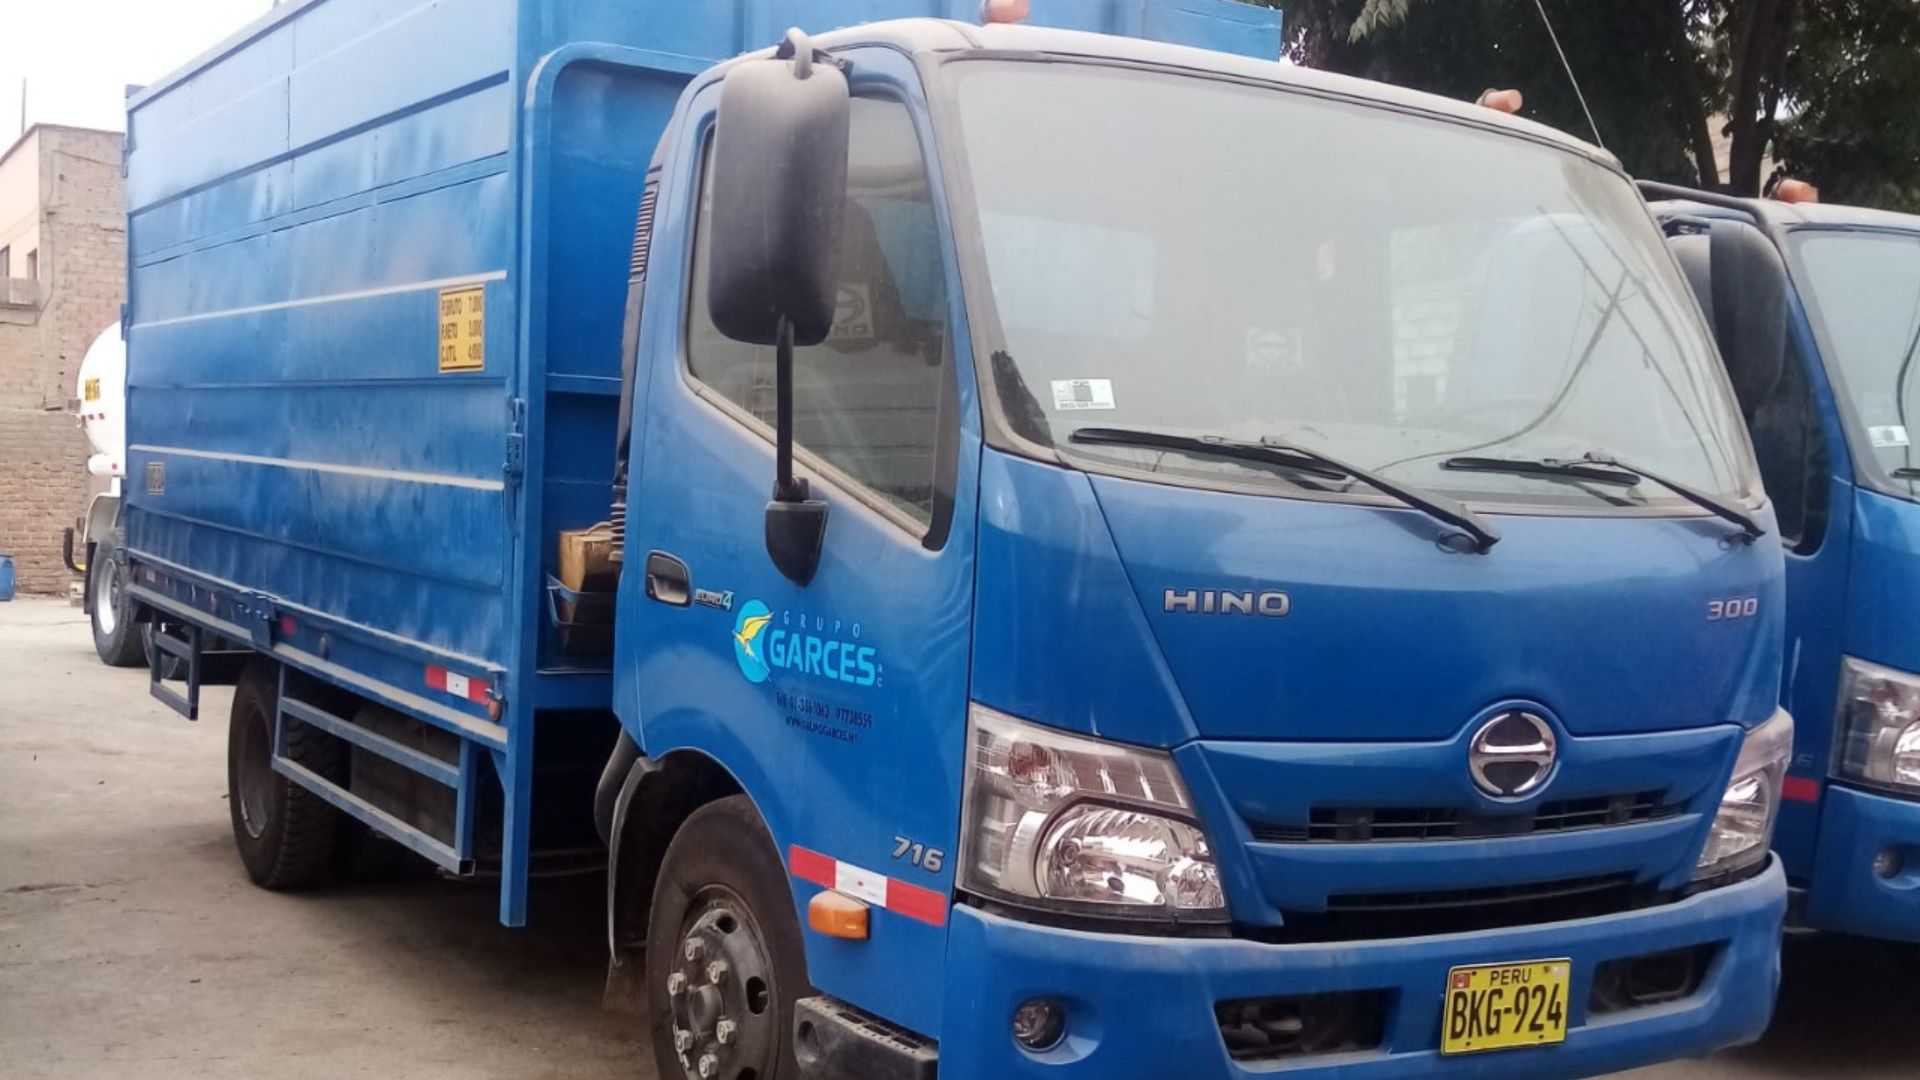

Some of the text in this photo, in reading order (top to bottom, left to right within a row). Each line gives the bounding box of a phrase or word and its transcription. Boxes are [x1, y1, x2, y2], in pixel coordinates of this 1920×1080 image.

[1164, 588, 1290, 617] HINO
[1706, 597, 1758, 621] 300
[783, 610, 861, 638] GRUPO
[769, 628, 876, 686] GARCES
[892, 834, 945, 873] 716
[1489, 967, 1532, 986] PERU
[1450, 983, 1563, 1040] BKG-924
